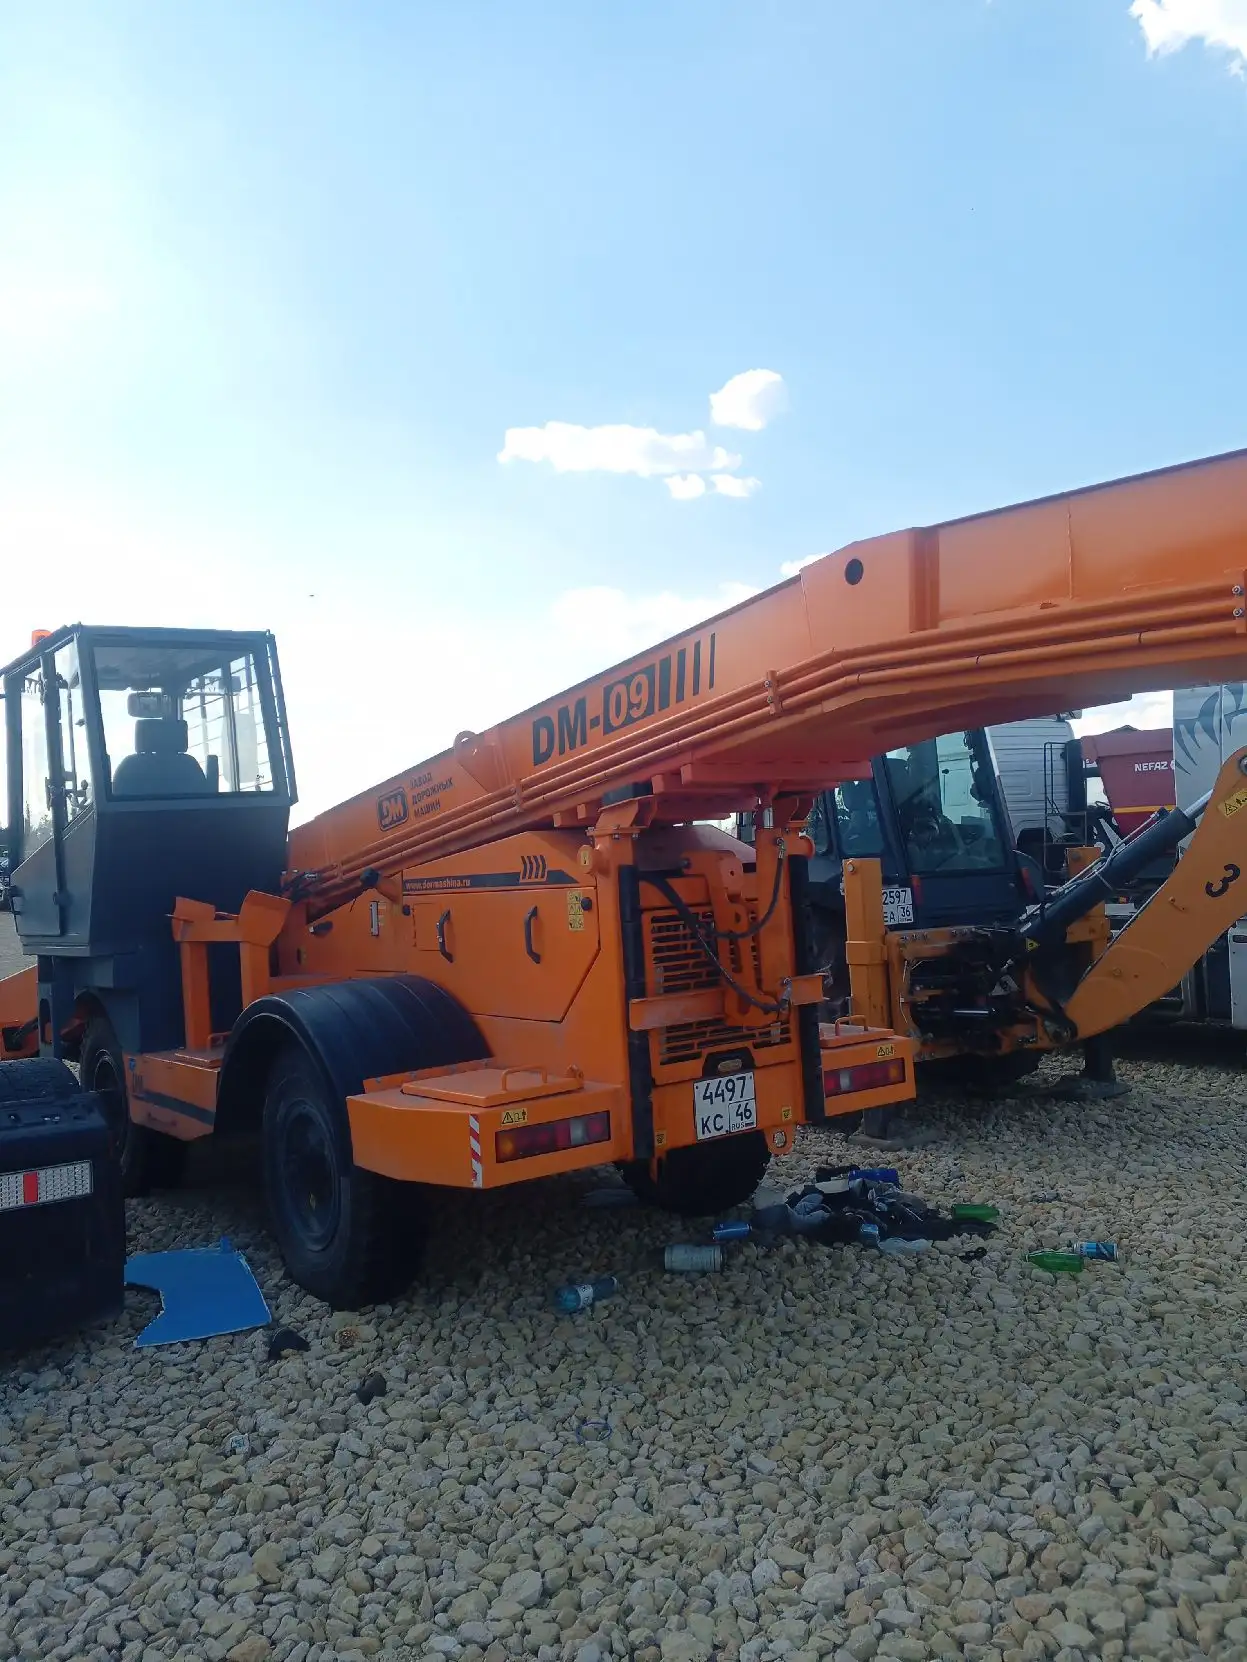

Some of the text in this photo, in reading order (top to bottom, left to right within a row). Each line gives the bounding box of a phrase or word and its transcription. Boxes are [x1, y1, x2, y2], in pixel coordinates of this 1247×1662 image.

[532, 673, 649, 767] DM-09
[1134, 761, 1168, 771] NEFAZ
[412, 777, 453, 805] ДОРОЖНЫХ
[414, 798, 440, 817] МАШИН
[1205, 864, 1241, 897] 3
[882, 890, 906, 905] 2597
[900, 906, 911, 917] 36
[702, 1076, 746, 1105] 4497
[735, 1102, 752, 1121] 46
[701, 1113, 724, 1135] KC
[731, 1122, 745, 1131] RUS
